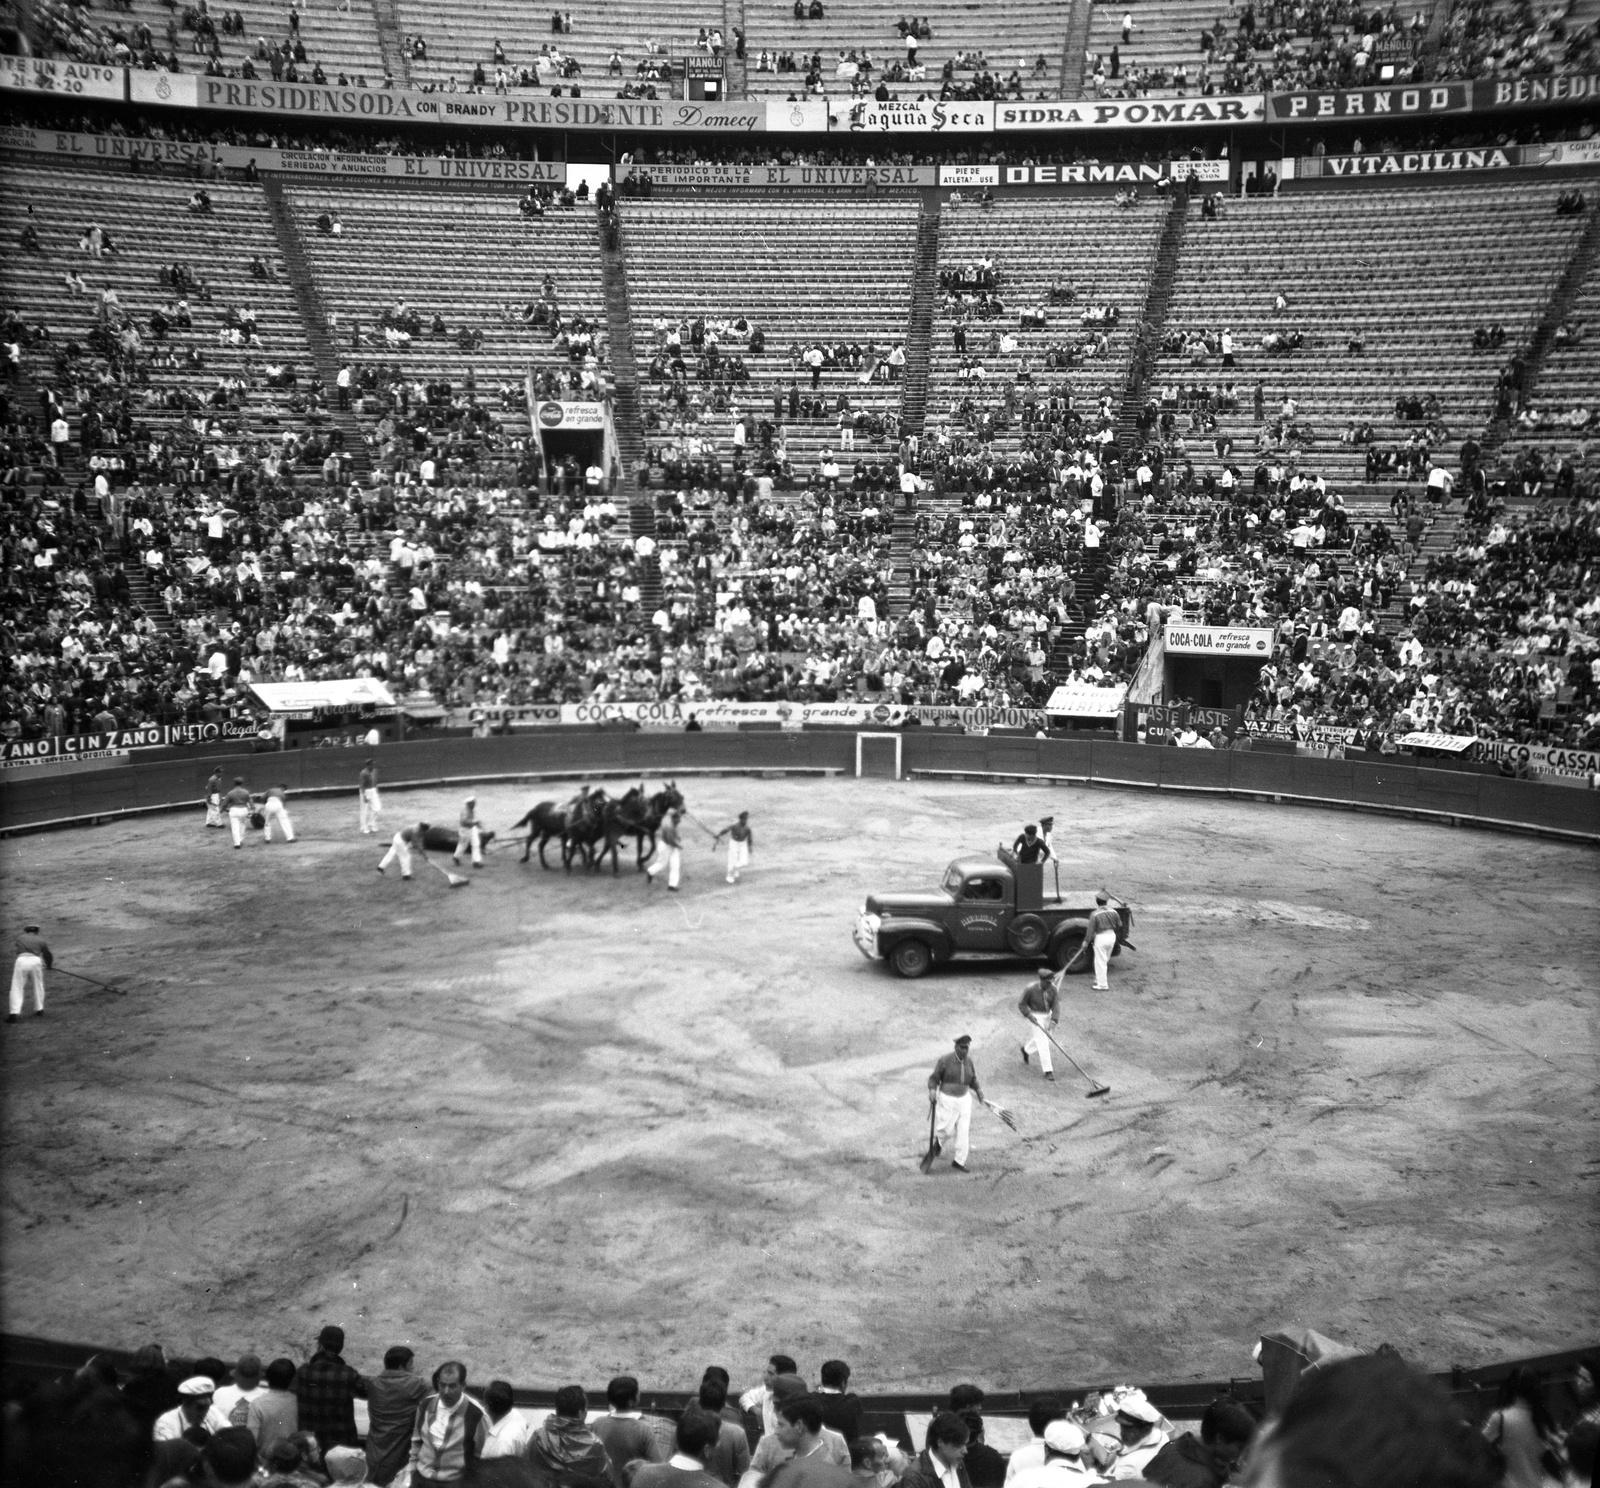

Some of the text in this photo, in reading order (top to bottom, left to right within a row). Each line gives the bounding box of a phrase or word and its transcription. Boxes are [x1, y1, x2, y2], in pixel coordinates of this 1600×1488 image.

[33, 60, 56, 77] UN
[65, 65, 114, 82] AUTO
[689, 57, 723, 69] MANOLO
[205, 81, 759, 131] PRESIDENSODA CON BRANDY PRESIDENTE Domecq
[878, 102, 921, 111] MEZCAL
[1290, 87, 1449, 117] PERNOD
[850, 102, 985, 131] Laguna Seca
[1003, 100, 1249, 124] SIDRA POMAR
[55, 133, 218, 162] EL UNIVERSAL
[281, 151, 387, 165] CIRCULACION INFORMACION
[1328, 150, 1510, 175] VITACILINA
[281, 161, 387, 174] SERIEDAD Y ANUNCIOS
[404, 158, 558, 180] EL UNIVERSAL
[650, 166, 708, 175] PERIODICO
[715, 167, 729, 175] DE
[735, 167, 750, 175] LA
[767, 168, 919, 184] EL UNIVERSAL
[955, 167, 980, 175] PIE DE
[1006, 163, 1163, 183] DERMAN
[674, 175, 750, 184] IMPORTANTE
[565, 405, 598, 415] refresca
[576, 415, 603, 425] grande
[1218, 633, 1251, 641] refresca
[1226, 642, 1251, 652] grande
[468, 708, 559, 722] Cuervo
[577, 703, 683, 721] COCA COLA
[696, 704, 768, 717] refresca
[803, 705, 858, 721] grande
[963, 707, 1045, 727] GORDON'S
[1189, 710, 1229, 727] HASTE
[65, 728, 160, 753] CINZANO
[172, 724, 219, 743] NIETO
[3, 759, 31, 768] EXTRA
[1547, 749, 1599, 773] CASSA
